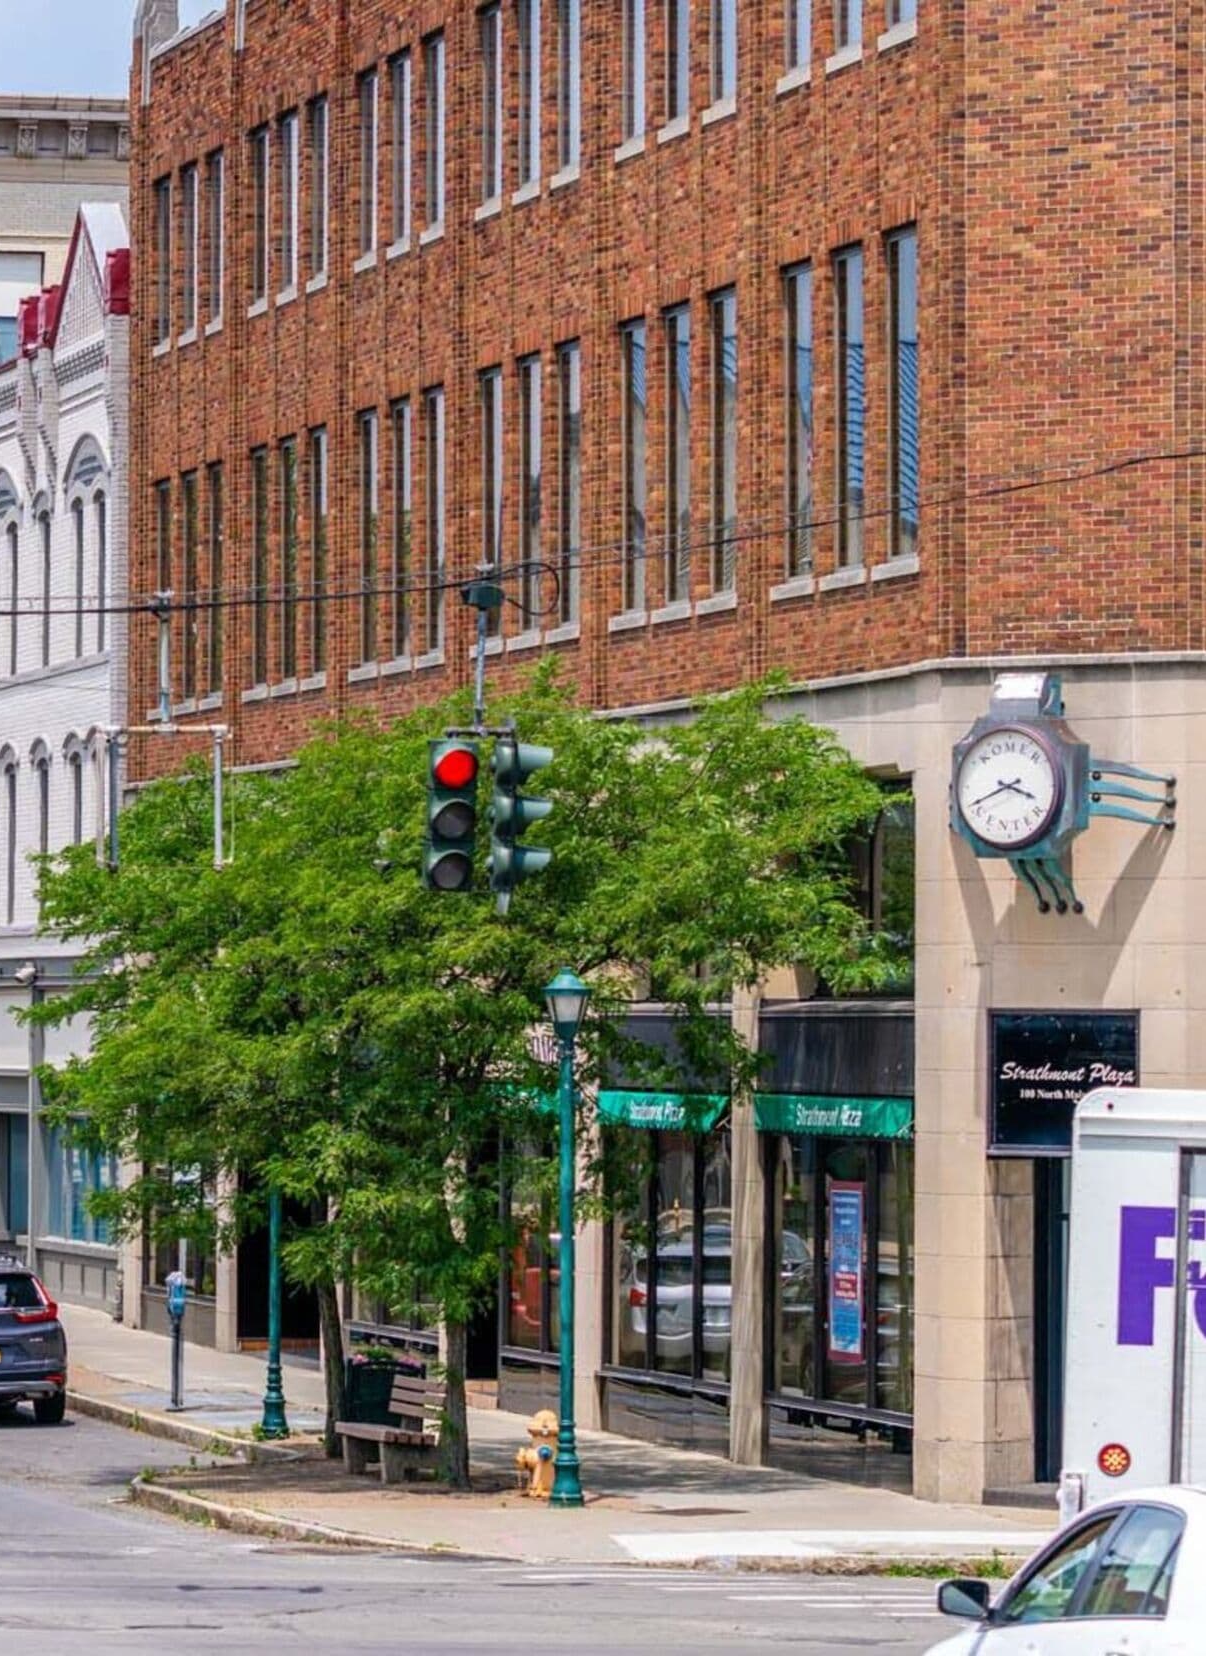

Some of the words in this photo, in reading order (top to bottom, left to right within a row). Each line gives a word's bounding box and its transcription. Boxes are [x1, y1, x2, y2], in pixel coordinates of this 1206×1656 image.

[979, 741, 1041, 764] KOMER
[975, 805, 1044, 831] CENTER
[1000, 1062, 1086, 1082] Strathmont
[1088, 1062, 1136, 1087] Plaza
[1019, 1088, 1036, 1099] 100
[1037, 1088, 1064, 1100] North
